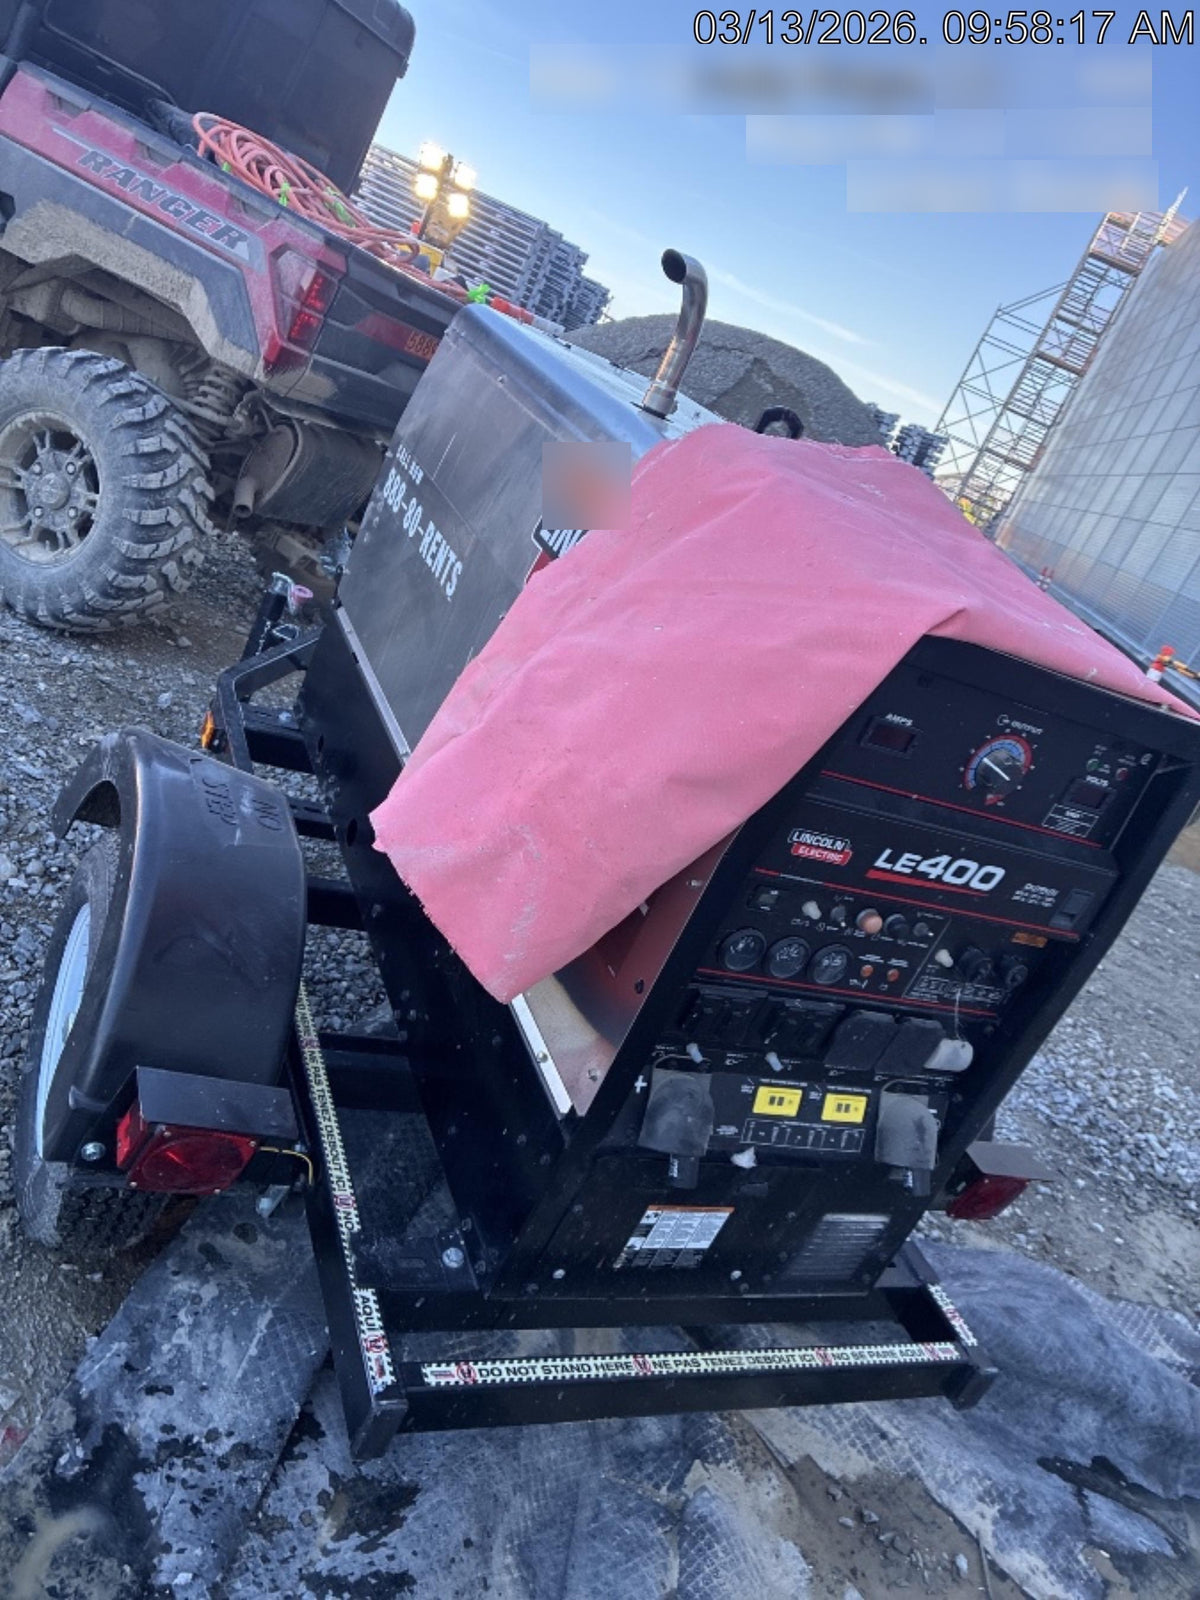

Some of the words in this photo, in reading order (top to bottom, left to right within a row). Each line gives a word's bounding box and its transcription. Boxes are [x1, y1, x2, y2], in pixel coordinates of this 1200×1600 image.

[76, 150, 250, 251] RANGER
[202, 777, 238, 827] STEP
[252, 799, 283, 832] NO
[792, 831, 845, 851] LINCOLN
[797, 845, 844, 862] ELECTRIC
[873, 847, 1006, 892] LE400
[312, 1066, 323, 1086] PAS
[316, 1087, 332, 1122] TENEZ
[325, 1124, 343, 1173] DEBOUT
[335, 1175, 348, 1192] ICI
[342, 1209, 355, 1231] NO
[360, 1295, 380, 1330] AQUI
[478, 1366, 502, 1379] DO
[506, 1364, 538, 1378] NOT
[543, 1362, 591, 1376] STAND
[594, 1360, 634, 1373] HERE
[652, 1358, 673, 1370] NE
[674, 1357, 700, 1369] PAS
[703, 1356, 744, 1367] TENEZ
[748, 1354, 799, 1365] DEBOUT
[801, 1352, 815, 1363] ICI
[833, 1351, 849, 1361] NO
